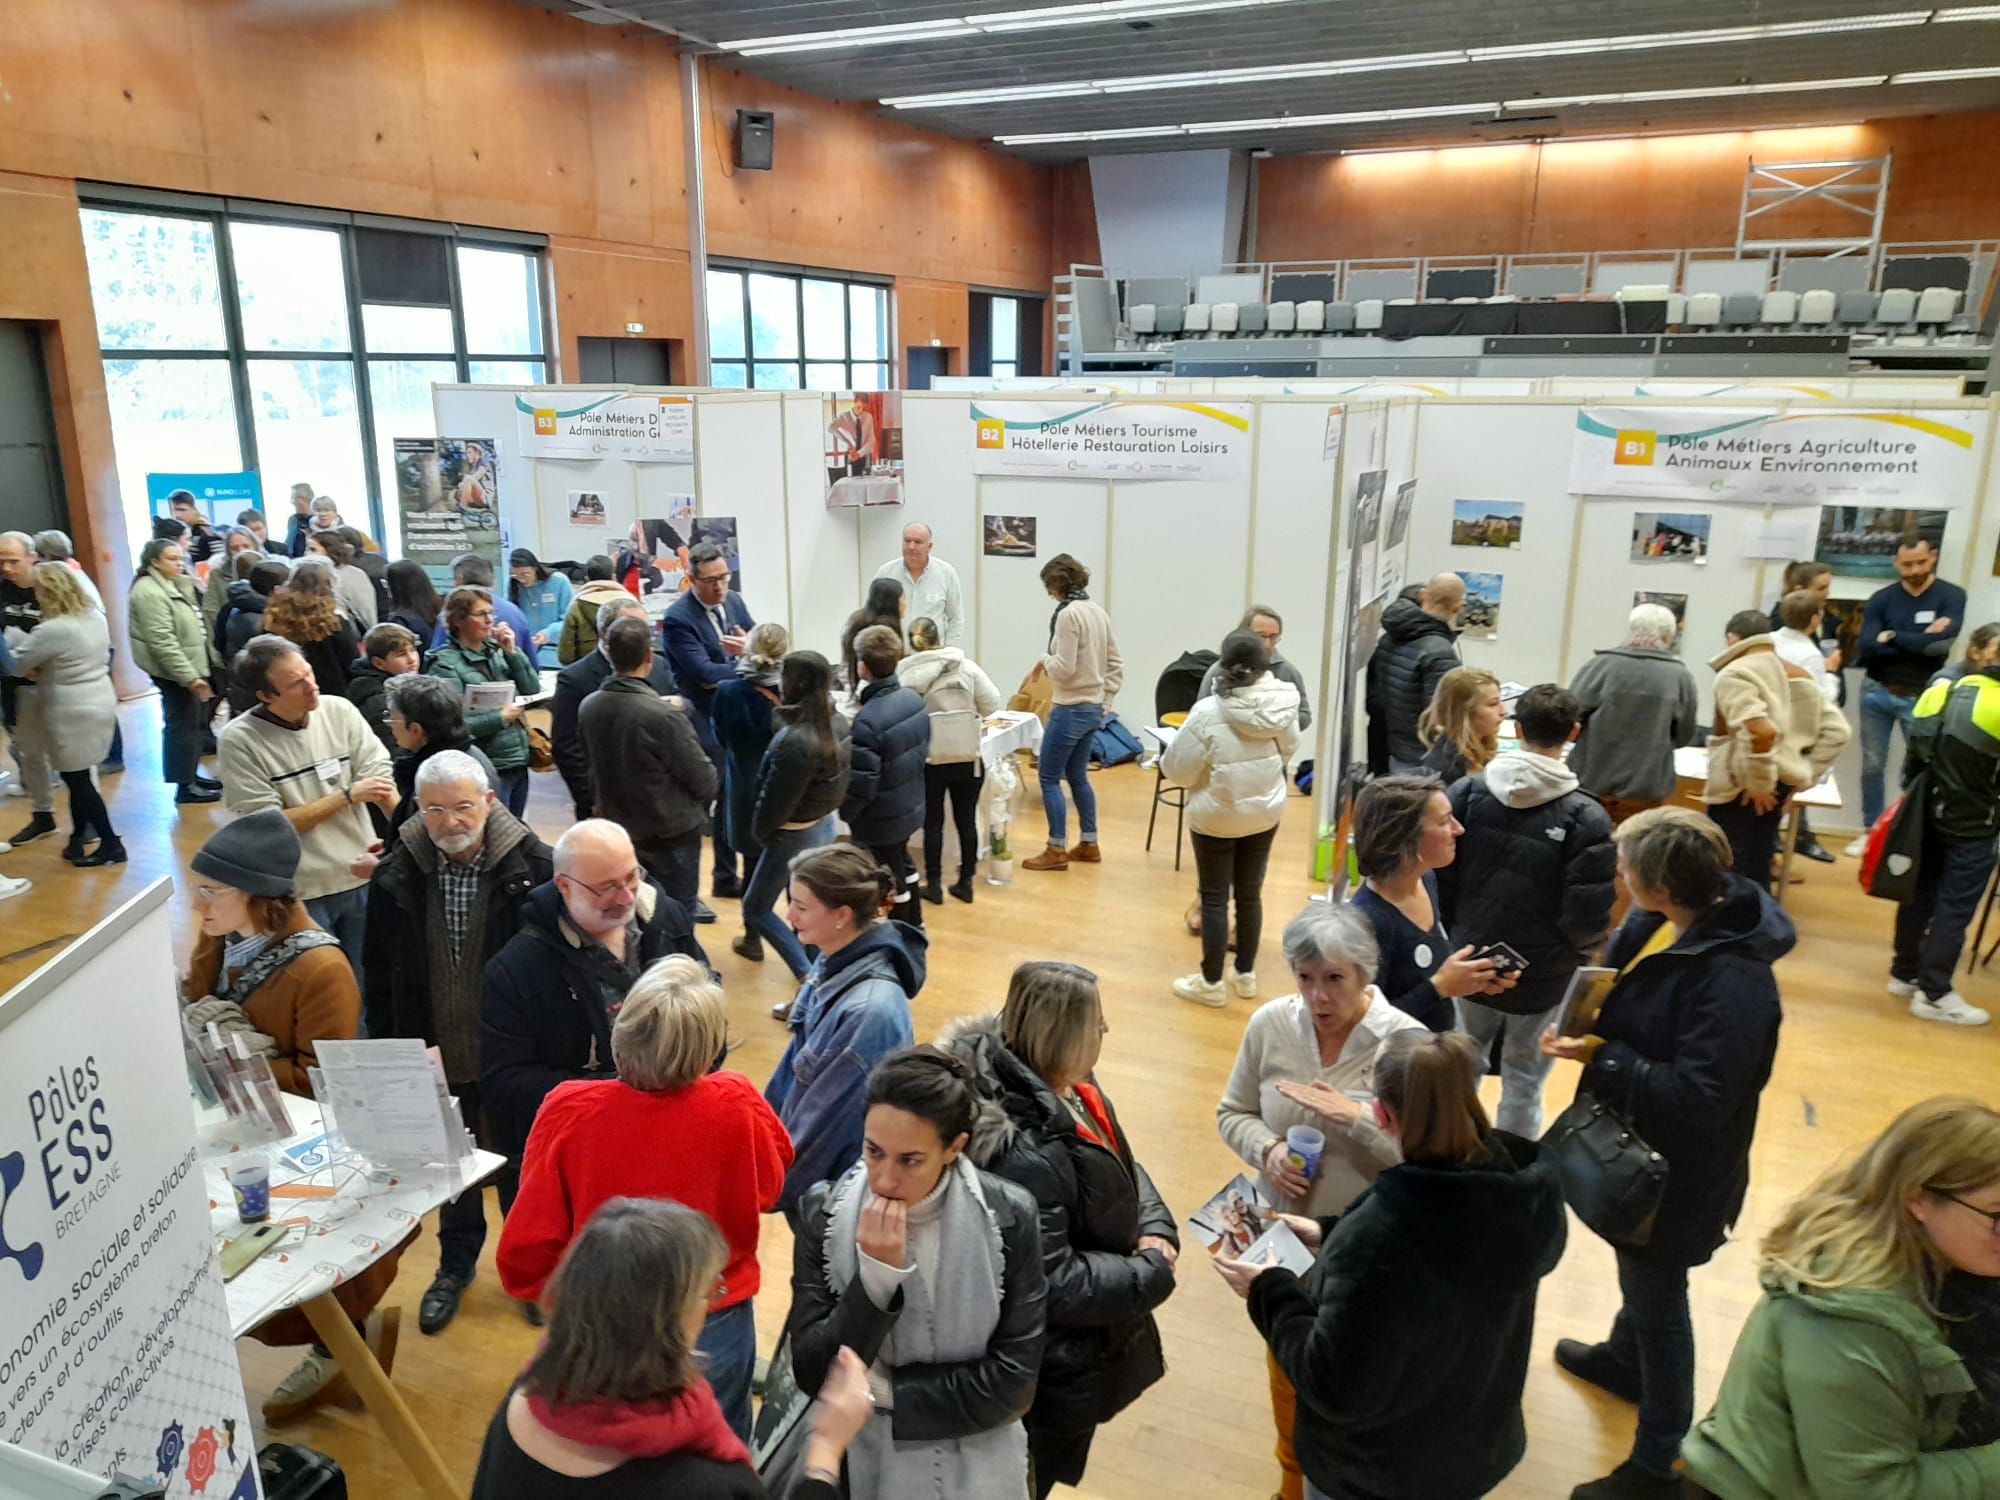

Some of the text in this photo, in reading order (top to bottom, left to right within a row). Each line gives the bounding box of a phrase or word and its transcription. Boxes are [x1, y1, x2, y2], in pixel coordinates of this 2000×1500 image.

[538, 417, 553, 428] B3
[580, 412, 601, 424] Pôle
[606, 413, 645, 425] Métiers
[1040, 421, 1197, 437] Pôle Métiers Tourisme
[569, 426, 645, 438] Administration
[981, 428, 999, 441] B2
[1012, 437, 1228, 454] Hôtellerie Restauration Loisirs
[1624, 441, 1647, 456] B1
[1668, 435, 1917, 458] Pôle Métiers Agriculture
[1666, 453, 1918, 474] Animaux Environnement
[41, 1098, 112, 1211] ESS
[56, 1160, 122, 1239] BRETAGNE
[72, 1228, 130, 1301] sociale
[133, 1204, 146, 1232] et
[149, 1146, 199, 1214] solidaire
[8, 1208, 177, 1410] vers un écosystème breton
[57, 1362, 69, 1388] et
[73, 1306, 124, 1367] d'outils
[110, 1336, 175, 1424] collectives
[55, 1439, 69, 1461] la
